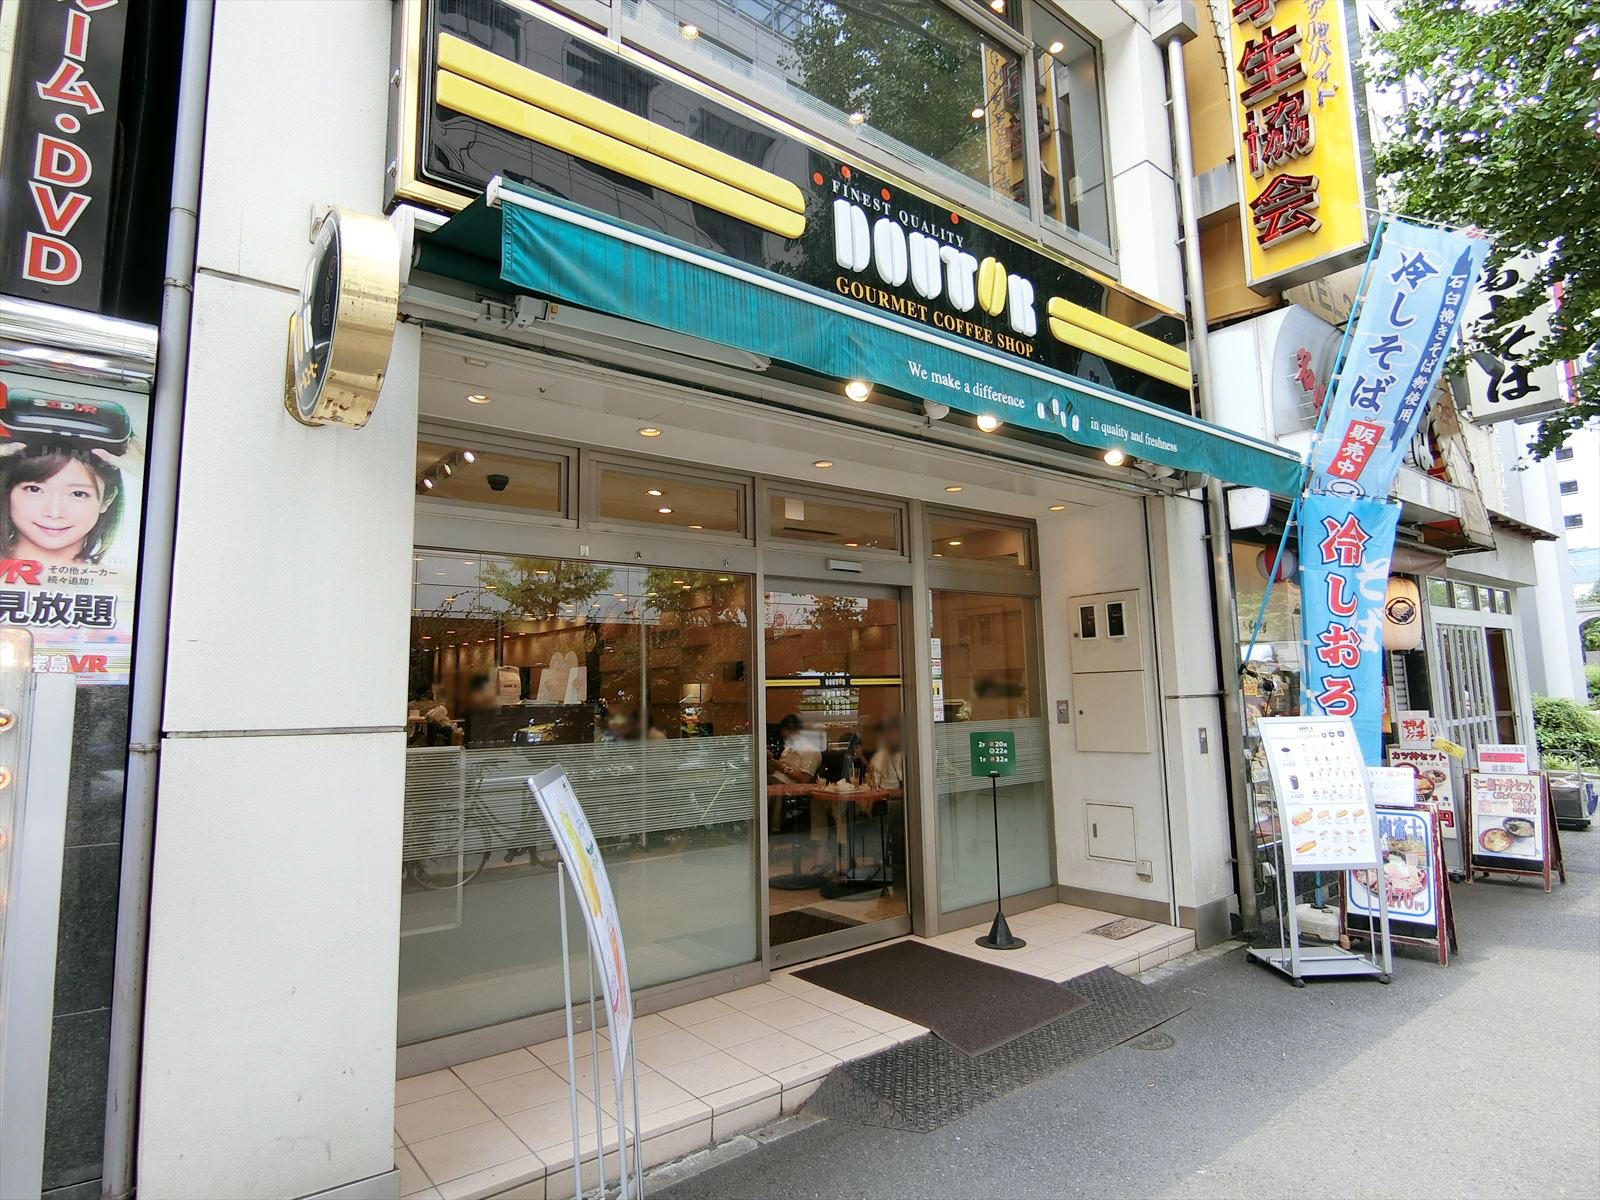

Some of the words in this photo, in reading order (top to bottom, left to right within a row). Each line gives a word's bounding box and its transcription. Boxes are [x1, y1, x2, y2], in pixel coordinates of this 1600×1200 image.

[22, 0, 119, 286] ーム・DVD
[832, 179, 891, 216] FINEST
[899, 210, 964, 248] QUALITY
[833, 199, 1037, 337] DOUTOR
[836, 276, 928, 322] GOURMET
[933, 310, 993, 345] COFFEE
[997, 333, 1034, 358] SHOP
[1349, 251, 1440, 413] 冷しそば
[1396, 274, 1469, 424] 石臼挽きそば粉使用
[907, 361, 928, 380] We
[931, 372, 961, 391] make
[964, 382, 970, 394] a
[972, 382, 1025, 409] difference
[1090, 417, 1099, 431] in
[1101, 421, 1129, 442] quality
[1131, 430, 1144, 444] and
[1145, 432, 1178, 453] freshness
[1337, 423, 1376, 476] 販売中
[0, 589, 115, 627] 見放題
[48, 565, 119, 577] その他メーカー
[1391, 751, 1447, 762] カツ丼セット
